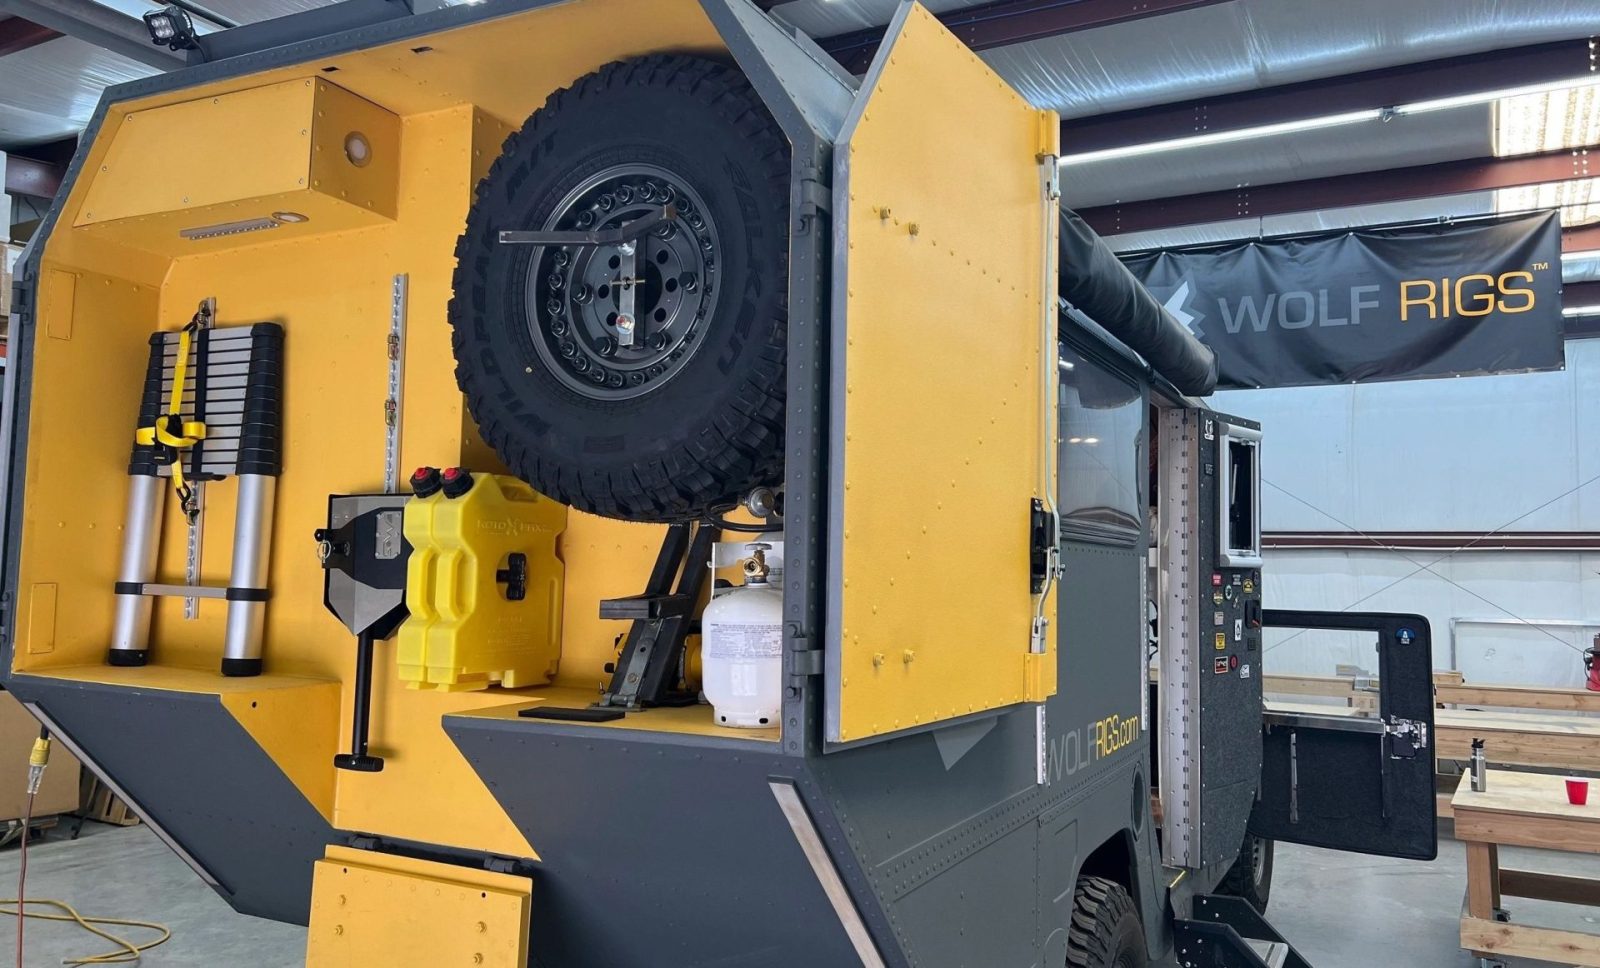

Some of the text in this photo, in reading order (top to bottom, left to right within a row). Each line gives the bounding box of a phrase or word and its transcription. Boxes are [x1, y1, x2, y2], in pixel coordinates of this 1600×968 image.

[472, 216, 552, 437] WILDPEAK
[717, 154, 763, 376] FALKEN
[1217, 284, 1380, 334] WOLF
